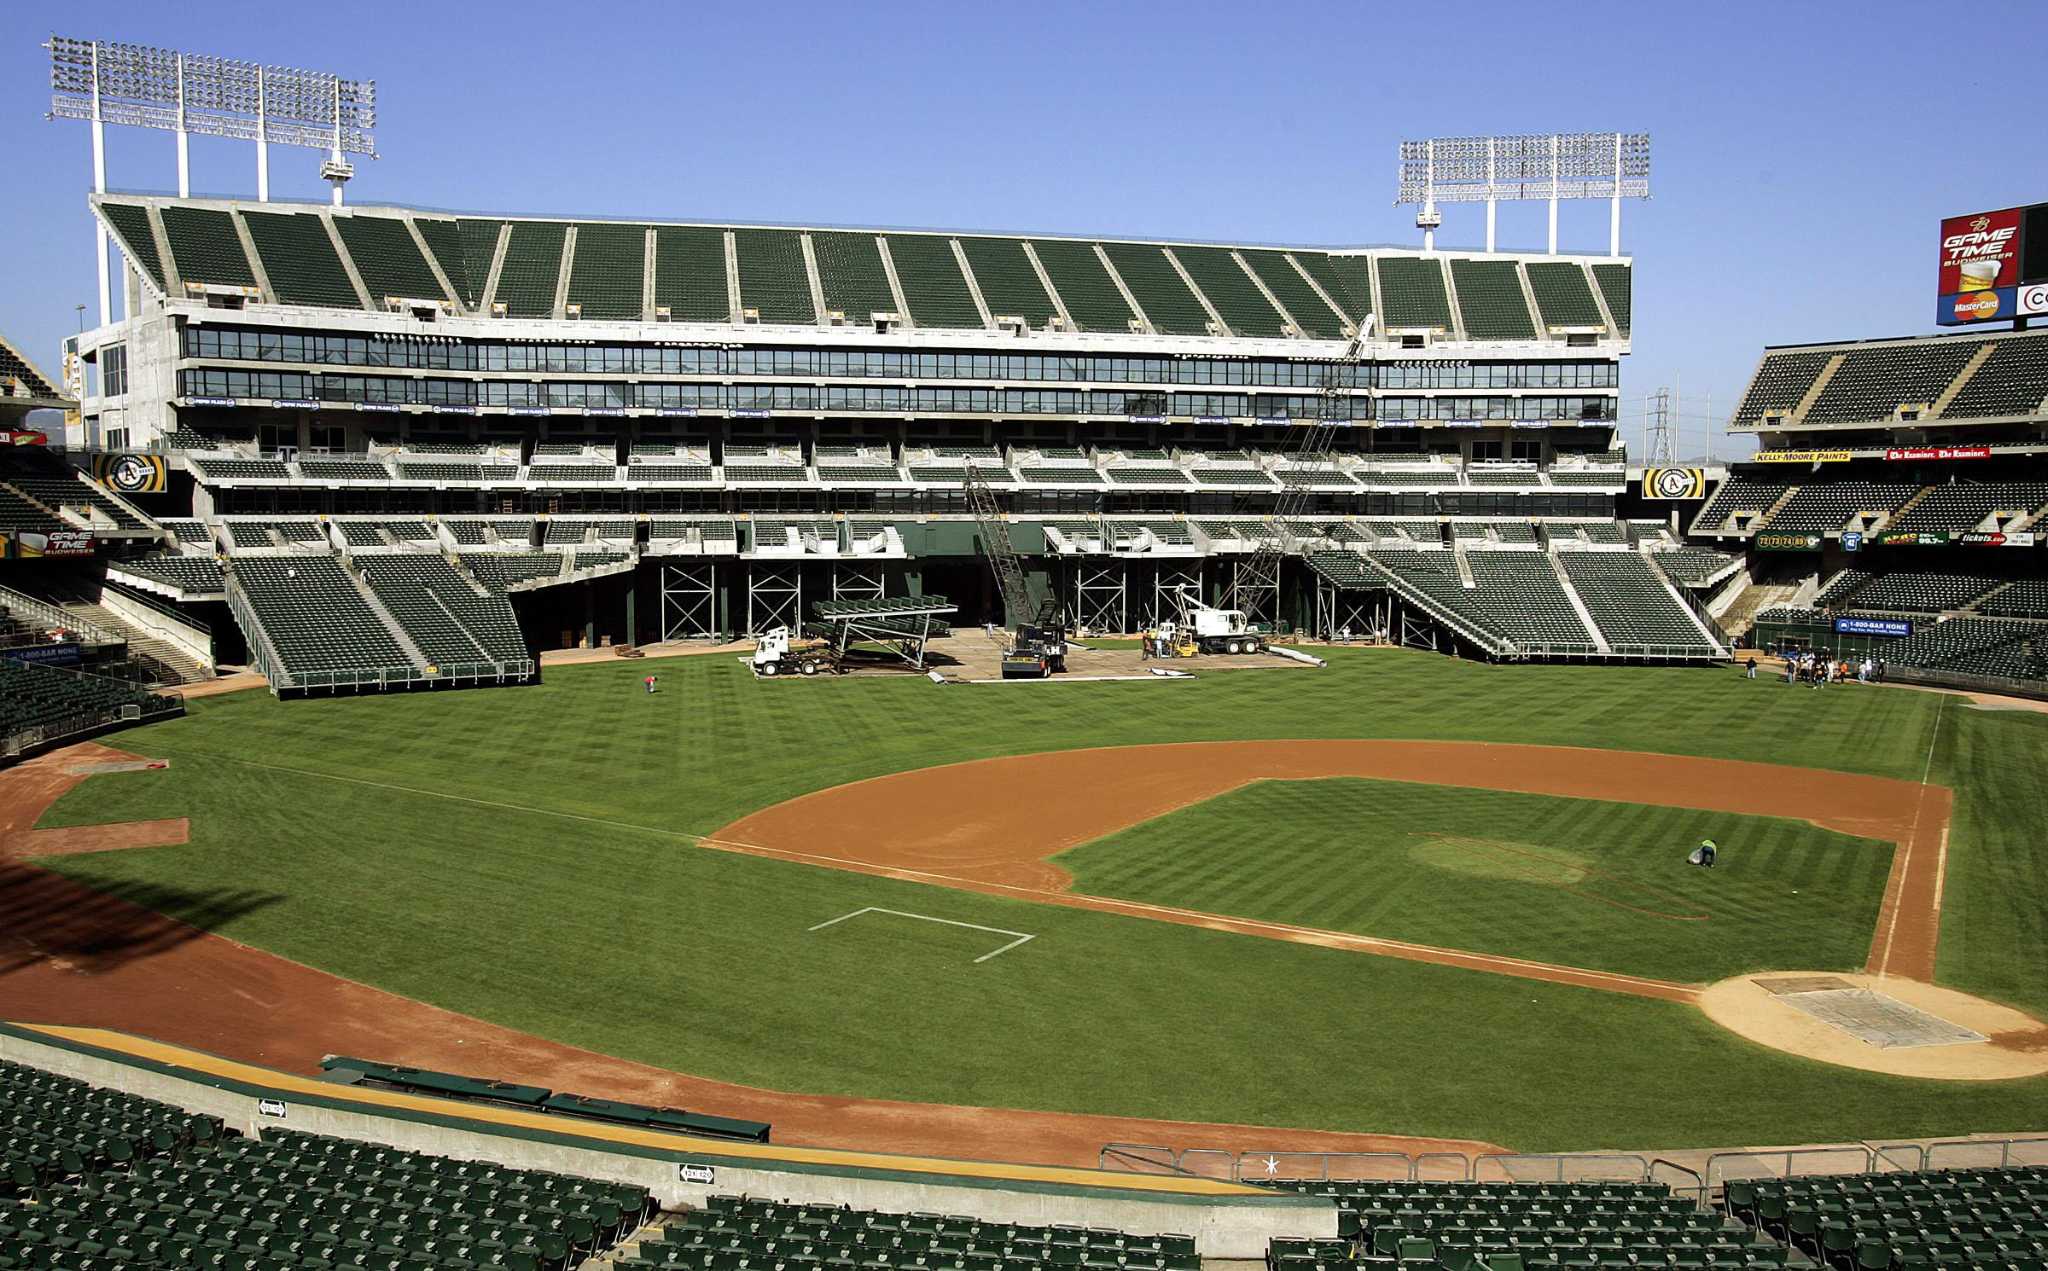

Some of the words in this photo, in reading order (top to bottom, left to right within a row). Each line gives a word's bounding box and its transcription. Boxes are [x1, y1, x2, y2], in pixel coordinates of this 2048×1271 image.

[1943, 226, 2017, 248] GAME
[1949, 240, 2007, 259] TIME
[1954, 300, 1999, 312] MasterCard
[1757, 452, 1815, 461] KELLY-MOORE
[1817, 452, 1849, 461] PAINTS
[49, 532, 93, 540] GAME
[53, 541, 88, 549] TIME
